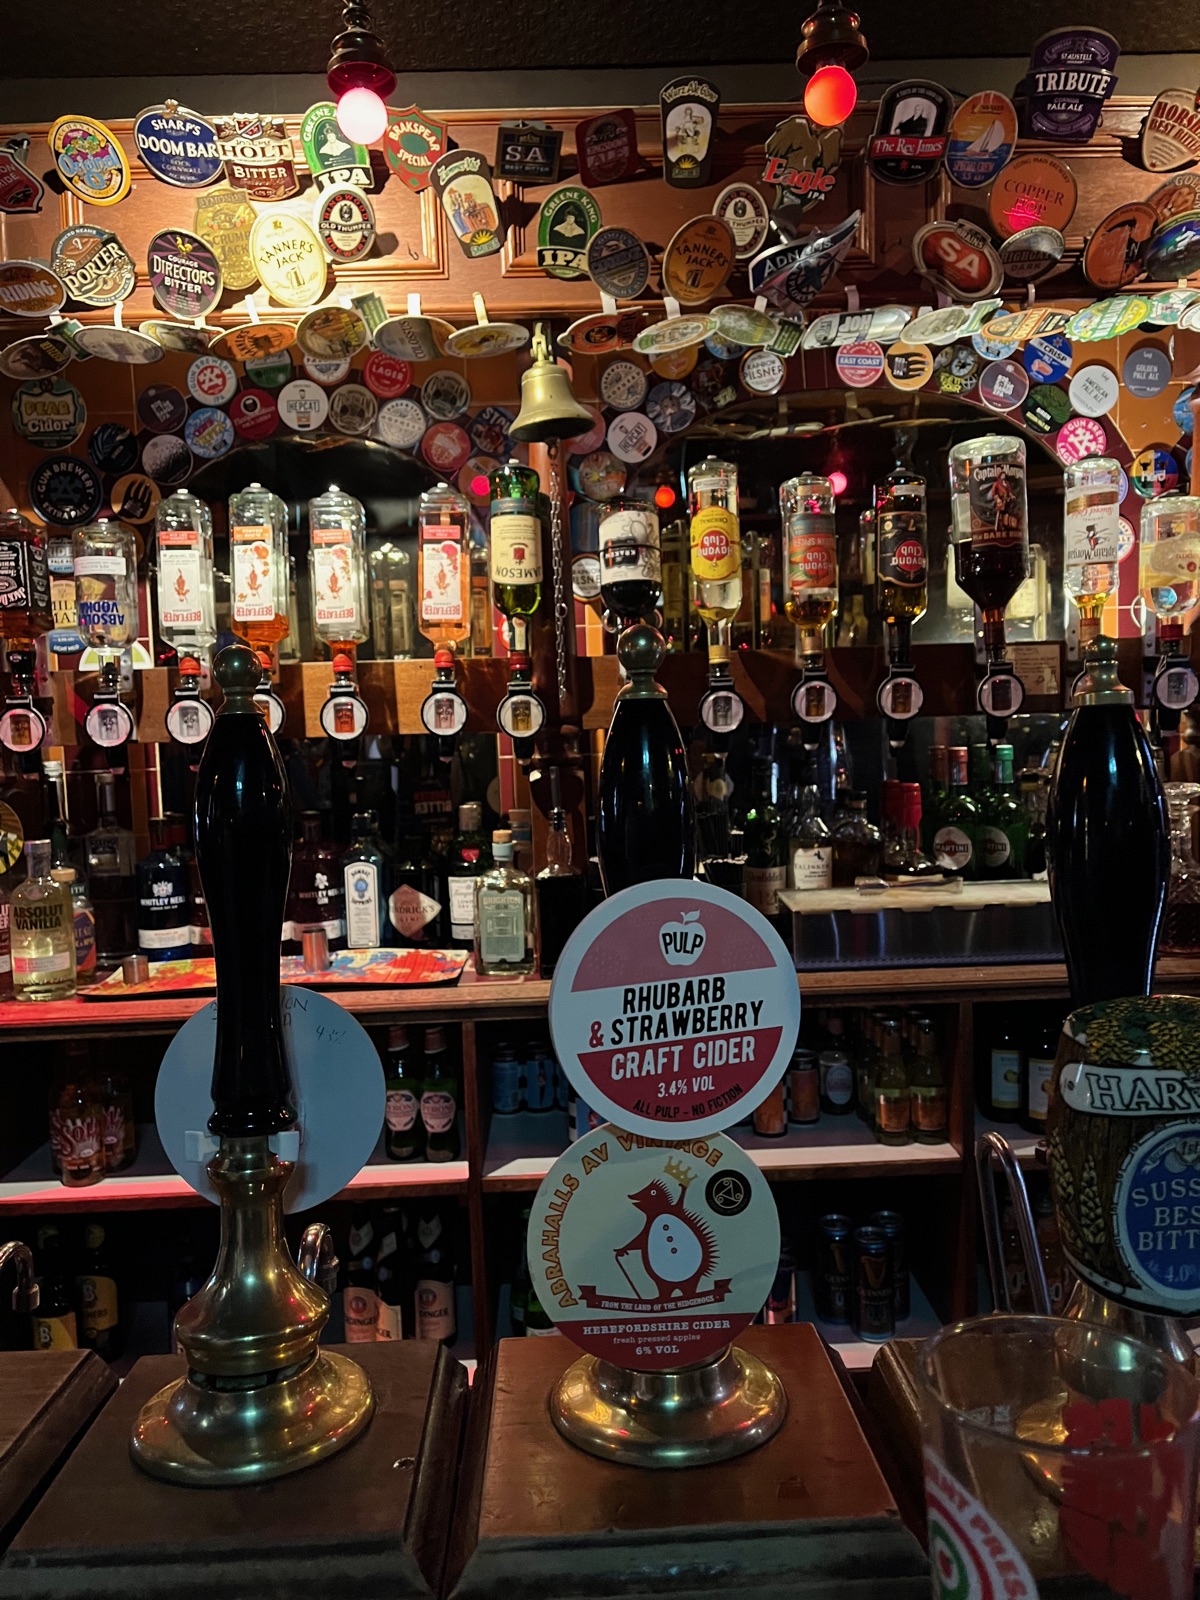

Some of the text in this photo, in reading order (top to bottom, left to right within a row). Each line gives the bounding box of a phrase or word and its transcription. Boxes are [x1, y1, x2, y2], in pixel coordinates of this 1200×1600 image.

[1035, 73, 1111, 95] TRIBUTE
[1047, 103, 1084, 112] PALE ALE
[151, 119, 201, 136] SHARP'S
[303, 108, 331, 142] GREENE
[1150, 118, 1175, 136] BEST
[389, 121, 441, 152] BRAKSPEAR
[138, 134, 219, 158] DOOM BAR
[218, 144, 290, 159] HOLT
[505, 145, 546, 163] SA
[875, 138, 944, 156] The Rev James
[397, 149, 432, 167] SPECIAL
[1013, 159, 1032, 169] LONG
[233, 165, 288, 179] BITTER
[318, 168, 371, 187] IPA
[763, 157, 836, 194] Eagle
[808, 191, 825, 201] IPA
[1005, 180, 1065, 205] COPPER
[323, 194, 369, 220] RINGWOOD
[543, 192, 598, 224] GREENE KING
[337, 223, 372, 232] THUMPER
[732, 219, 764, 227] THUMPER
[957, 227, 985, 249] BRAINS
[259, 239, 315, 265] TANNER'S
[326, 237, 367, 257] BREWERY
[676, 243, 729, 267] TANNER'S
[168, 254, 199, 268] COURAGE
[276, 252, 304, 268] JACK
[542, 250, 588, 271] IPA
[686, 255, 714, 269] JACK
[763, 238, 834, 278] ADNMS
[940, 237, 981, 280] SA
[62, 242, 126, 297] PORTER
[153, 255, 215, 287] DIRECTORS
[164, 278, 202, 294] BITTER
[840, 314, 873, 334] HOP
[401, 320, 427, 360] COLOSSUS
[840, 357, 881, 366] EAST COAST
[1043, 344, 1068, 362] CRISP
[372, 367, 405, 382] LAGER
[743, 364, 785, 381] PILSNER
[1136, 364, 1159, 372] GOLDEN
[1133, 373, 1159, 381] PALE ALE
[1081, 384, 1094, 396] PALE
[1085, 376, 1109, 399] AMERICAN
[288, 401, 318, 411] HEPCAT
[1067, 419, 1087, 431] GUN
[621, 424, 646, 452] HEPCAT
[1058, 443, 1079, 466] LAGER
[37, 462, 95, 497] GUN BREWERY
[972, 464, 1001, 481] Captain
[42, 502, 90, 521] EXTRA PALE
[907, 518, 916, 531] 7
[703, 535, 726, 546] Club
[605, 549, 637, 559] KRAKEN
[696, 547, 732, 557] Havana
[807, 551, 827, 562] Club
[900, 546, 923, 557] Club
[798, 562, 833, 571] Havana
[891, 556, 926, 567] Havana
[495, 564, 541, 578] JAMESON
[81, 602, 119, 613] VODKA
[236, 605, 273, 616] BEEFEATER
[317, 607, 354, 620] BEEFEATER
[424, 604, 460, 615] BEEFEATER
[80, 613, 125, 626] ABSOLUT
[164, 611, 202, 622] BEEFEATER
[13, 905, 63, 919] ABSOLUT
[661, 931, 704, 955] PULP
[623, 976, 726, 1015] RHUBARB
[588, 1000, 764, 1048] & STRAWBERRY
[611, 1035, 756, 1081] CRAFT CIDER
[657, 1075, 715, 1098] 3.4% VOL
[633, 1083, 743, 1119] ALL PULP NO FICTION
[541, 1134, 724, 1309] ABRAHALLS AV VINTAGE
[601, 1294, 715, 1311] FROM THE LAND OF THE HEDGEHOGS
[583, 1319, 731, 1336] HEREFORDSHIRE CIDER
[613, 1334, 701, 1346] fresh pressed apples
[635, 1345, 680, 1356] 6% VOL
